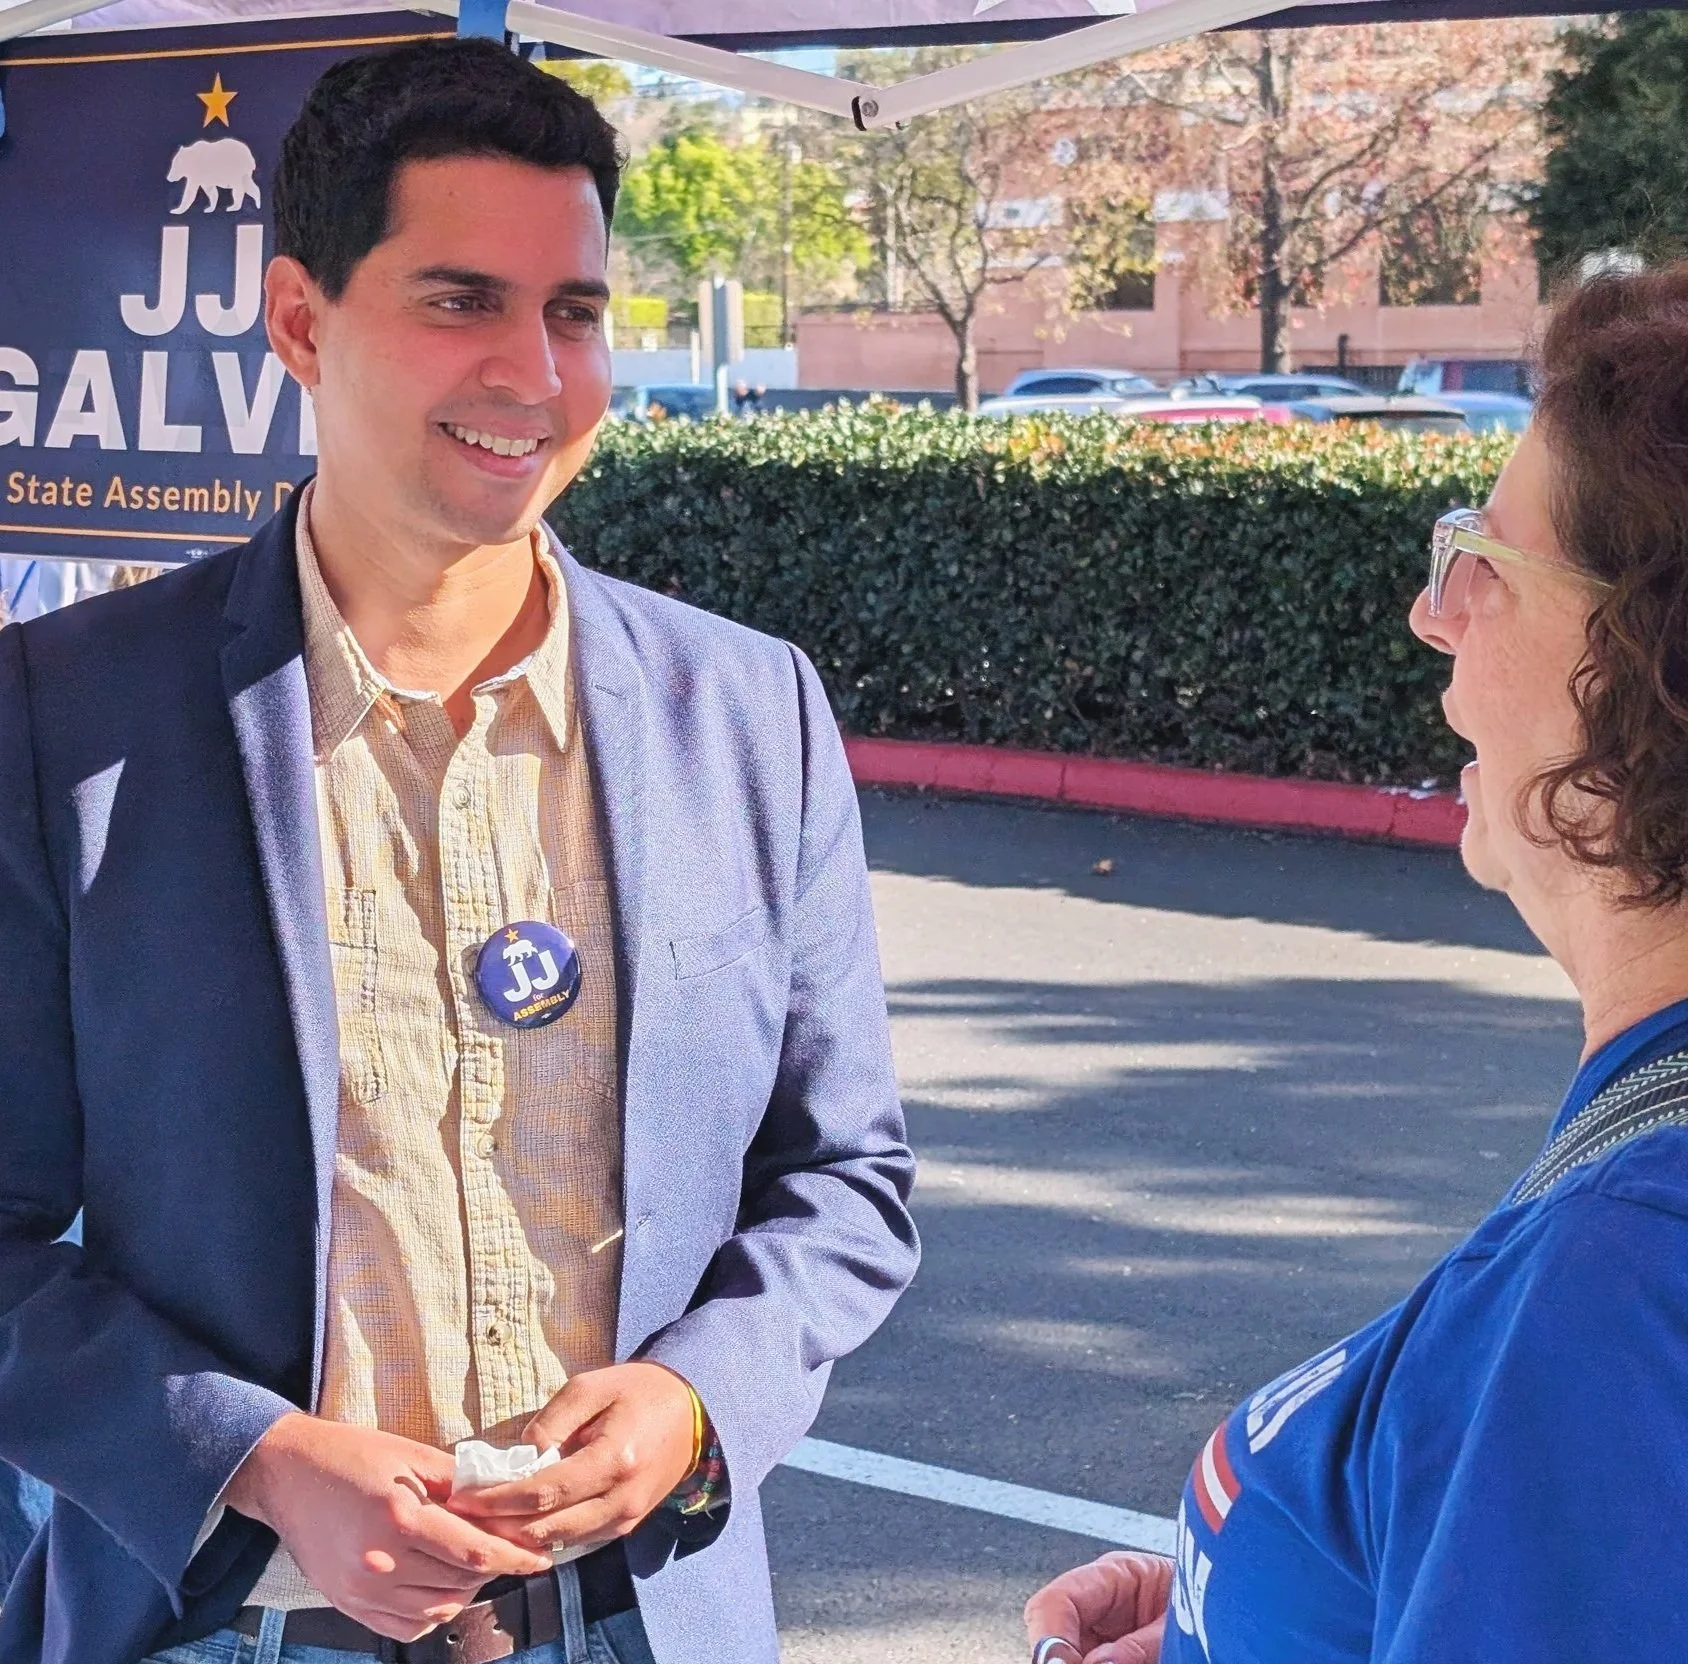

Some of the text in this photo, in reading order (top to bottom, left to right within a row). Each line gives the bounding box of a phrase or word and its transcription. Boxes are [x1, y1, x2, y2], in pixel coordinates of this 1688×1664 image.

[120, 224, 264, 337] JJ
[7, 471, 93, 507] State
[103, 475, 262, 521] Assembly
[503, 950, 559, 1002] JJ
[513, 989, 570, 1021] ASSEMBLY
